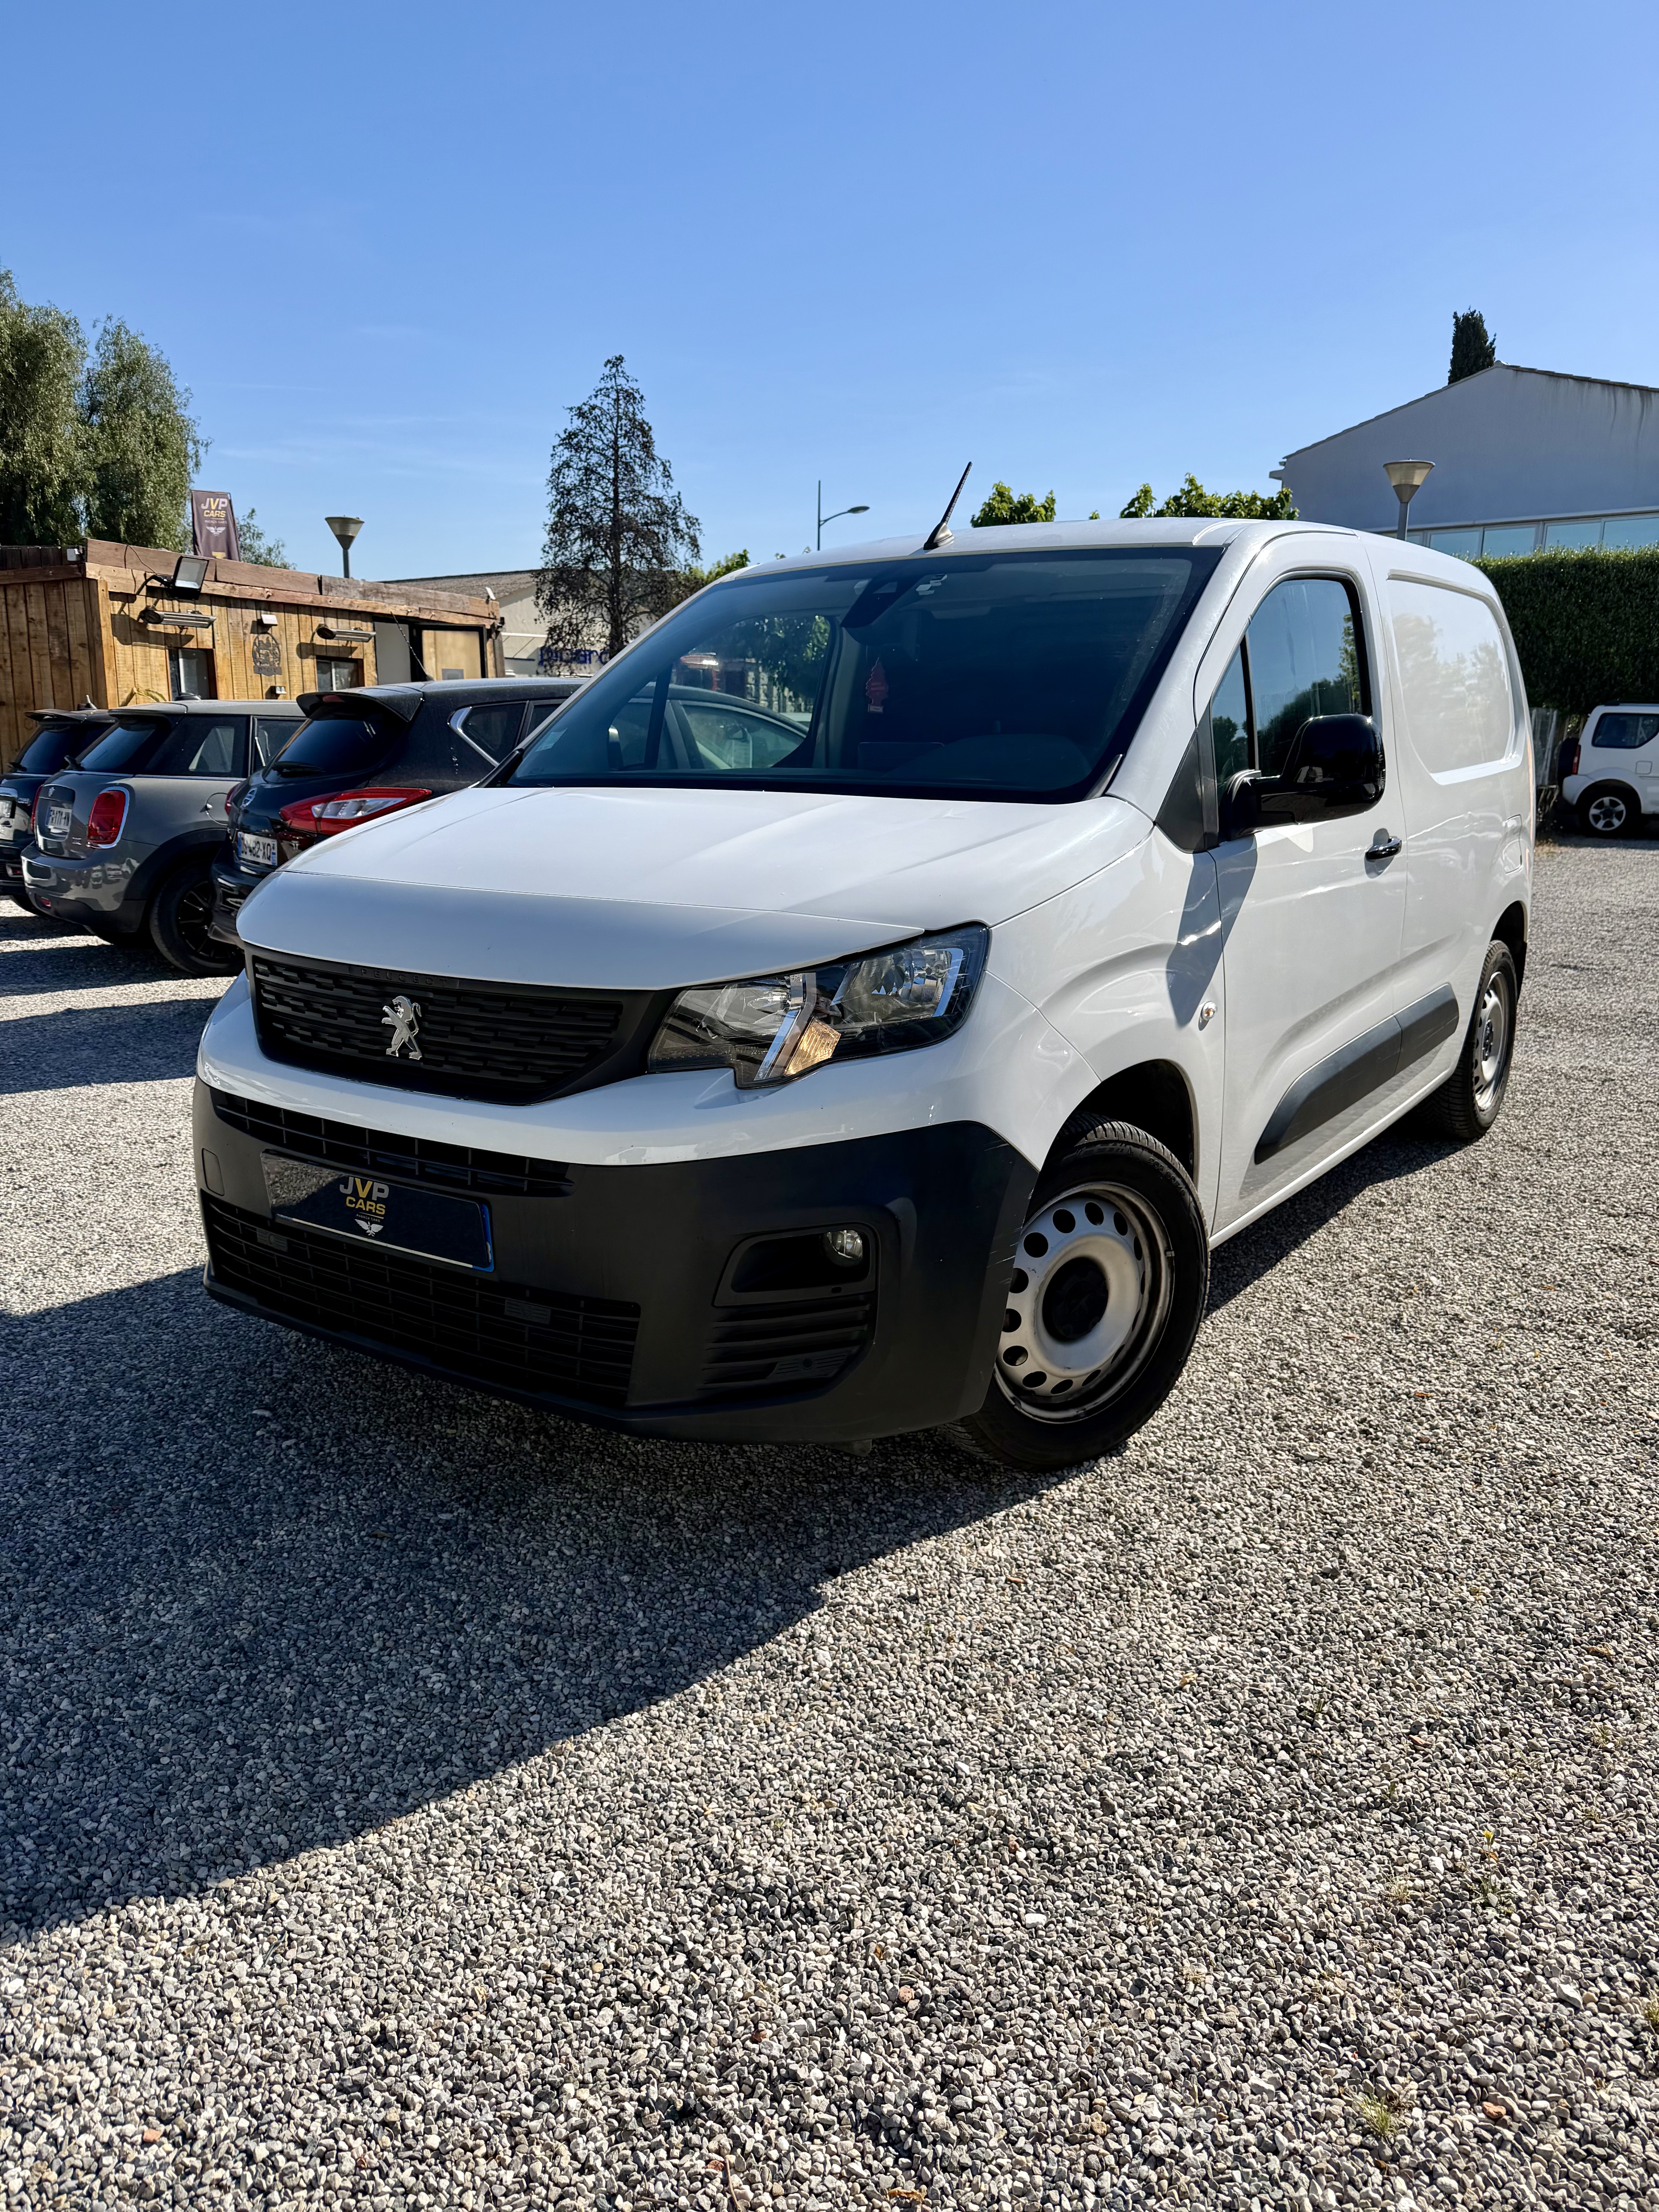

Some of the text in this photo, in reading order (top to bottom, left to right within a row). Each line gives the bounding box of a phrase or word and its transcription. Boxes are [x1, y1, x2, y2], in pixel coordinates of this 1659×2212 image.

[201, 498, 228, 510] JVP
[361, 968, 446, 987] PEUGEOT
[340, 1176, 389, 1201] JVP
[346, 1196, 386, 1215] CARS
